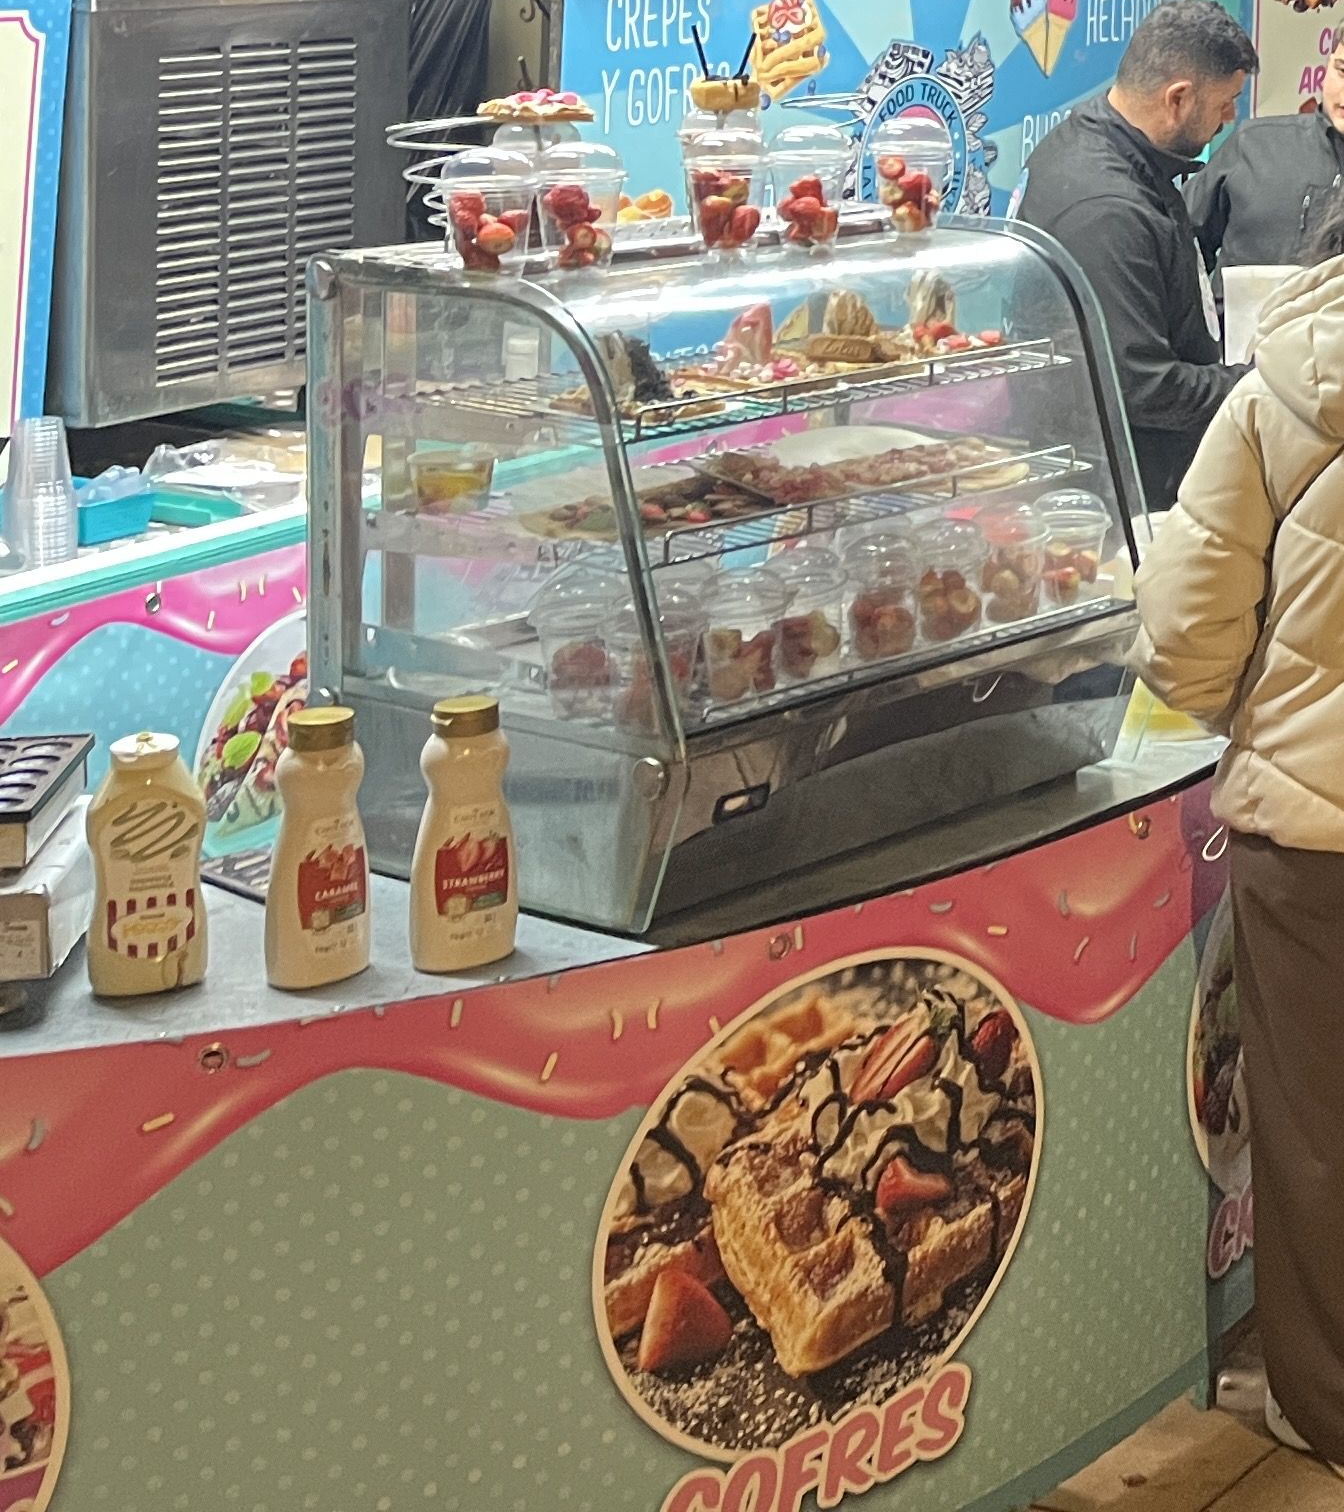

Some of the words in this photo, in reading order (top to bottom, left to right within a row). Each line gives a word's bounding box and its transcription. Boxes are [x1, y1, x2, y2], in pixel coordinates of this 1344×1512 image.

[602, 68, 621, 135] Y
[627, 61, 731, 126] GOFR
[879, 84, 915, 122] FOOD
[921, 83, 958, 128] TRUCK
